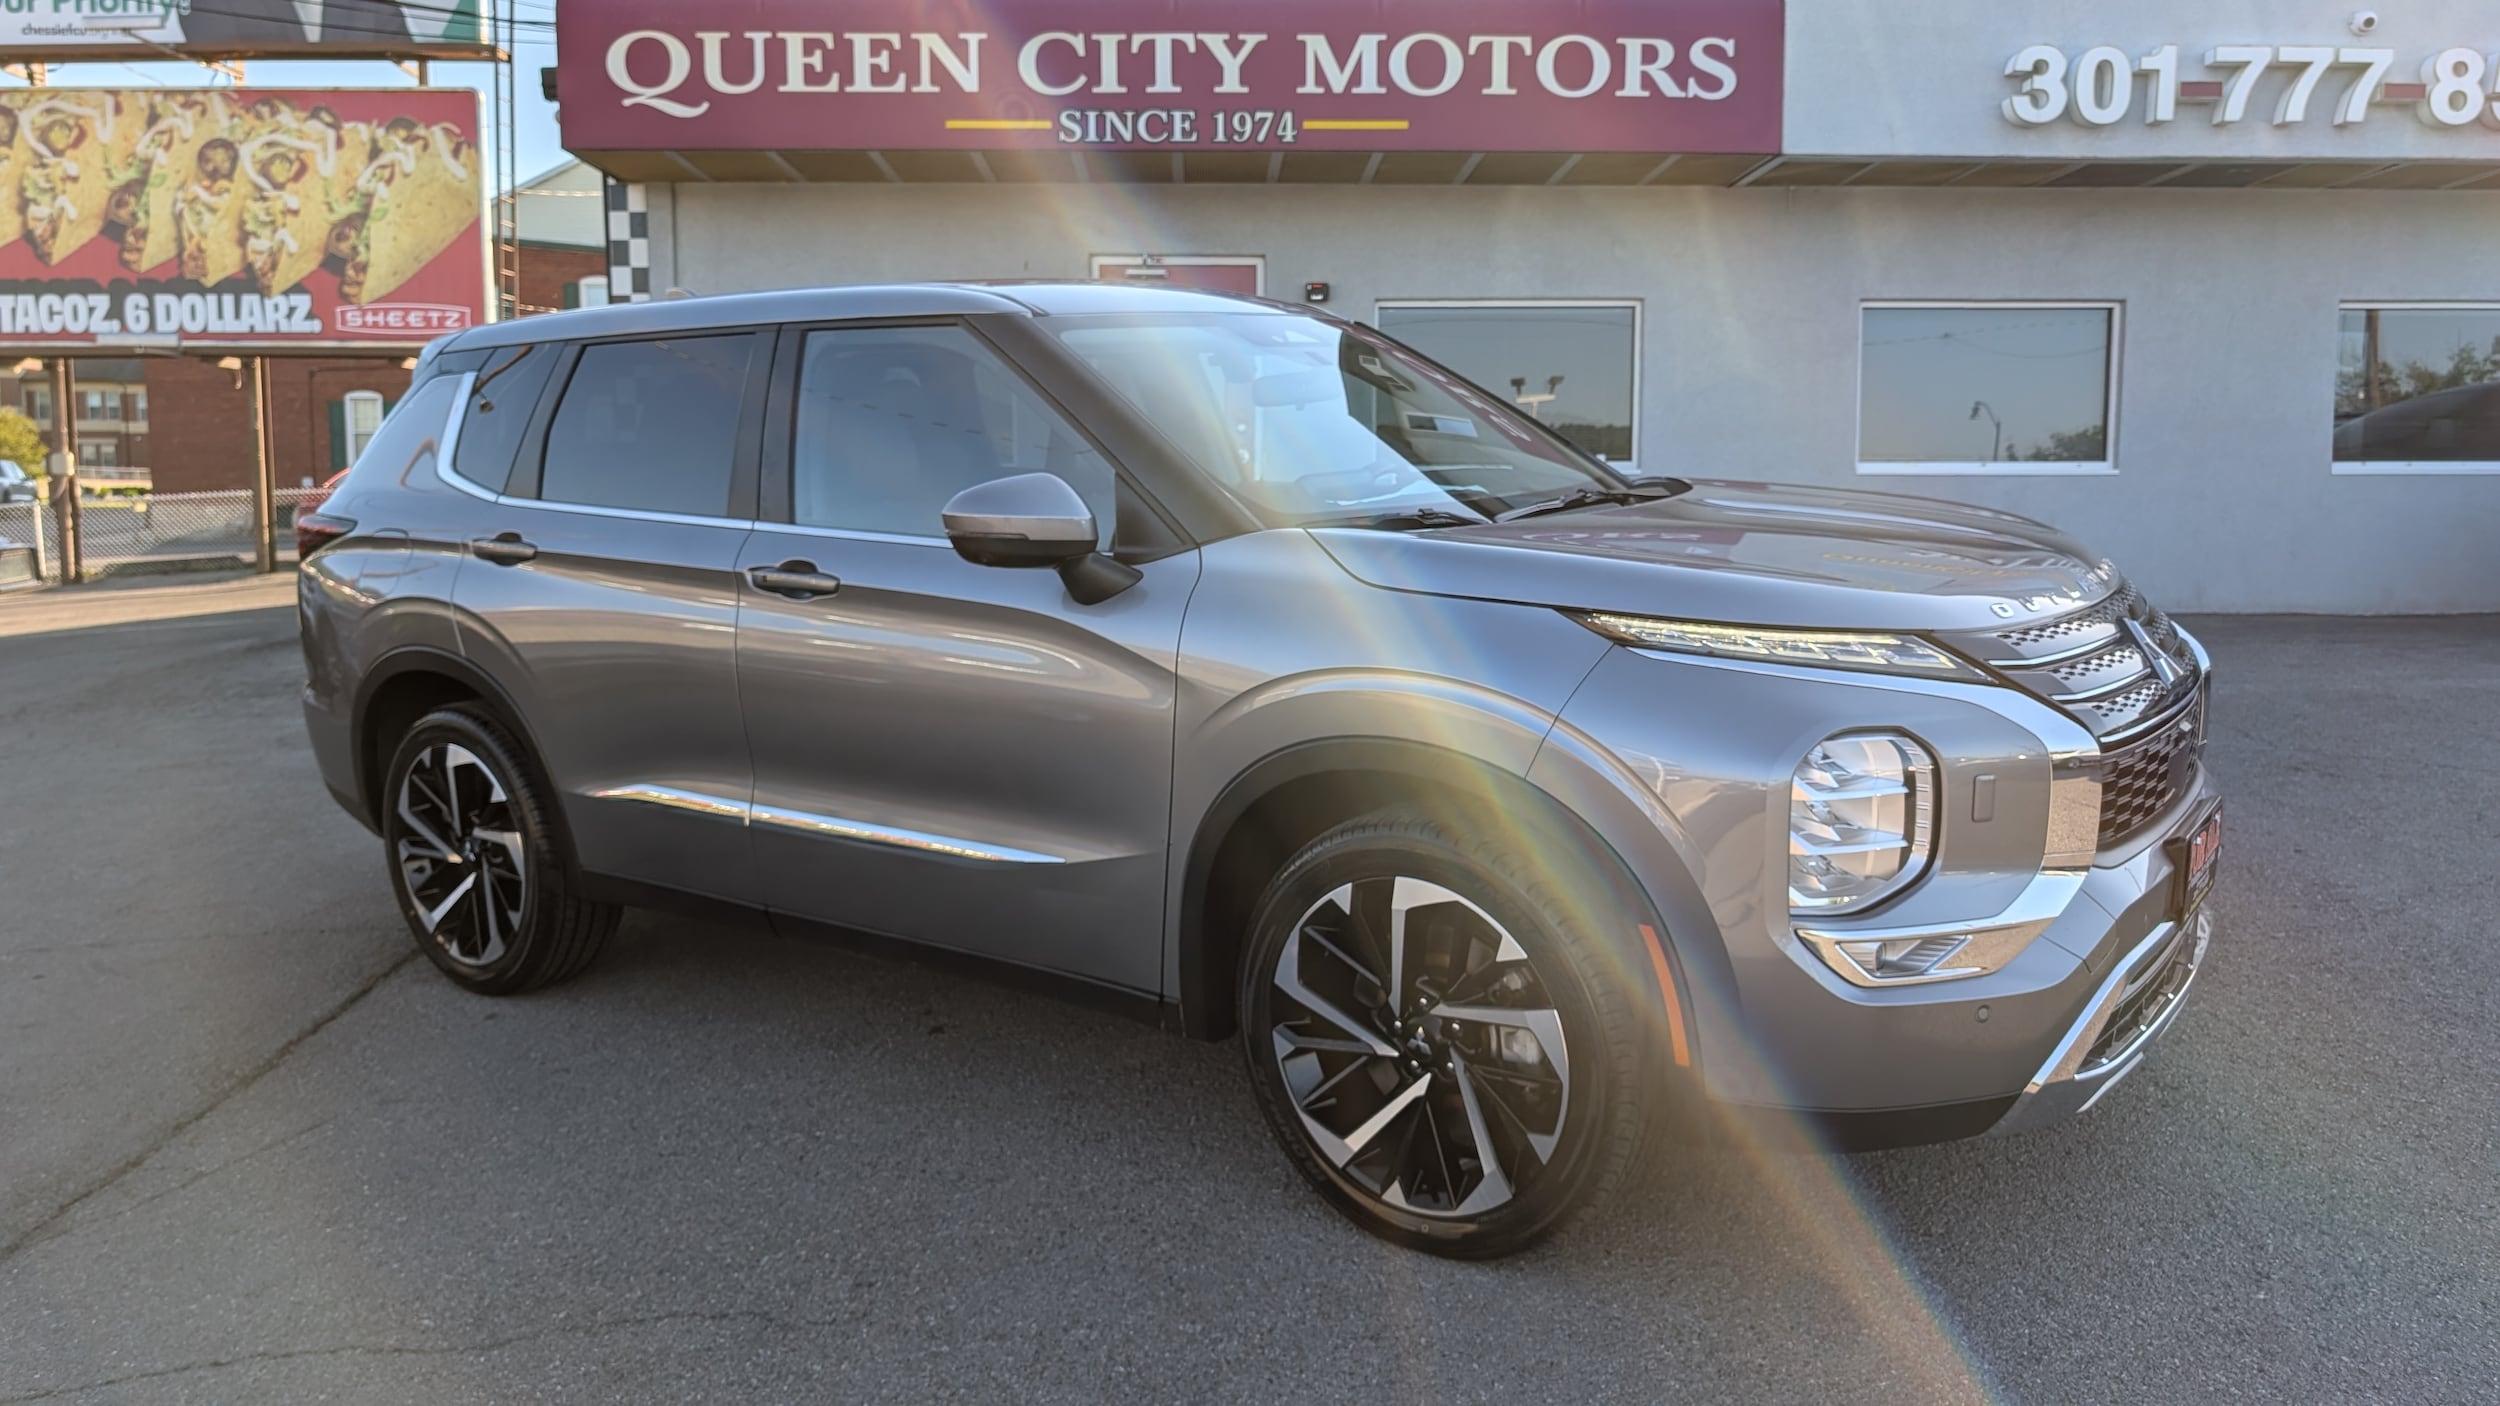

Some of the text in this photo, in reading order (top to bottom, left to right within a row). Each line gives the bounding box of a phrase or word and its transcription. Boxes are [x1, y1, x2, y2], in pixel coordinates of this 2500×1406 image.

[0, 0, 35, 13] ur
[605, 29, 1737, 118] QUEEN CITY MOTORS
[2003, 45, 2500, 127] 301-777-8
[1058, 109, 1298, 143] SINCE 1974
[0, 293, 323, 334] TACOZ. 6 DOLLARZ.
[345, 309, 462, 328] SHEETZ
